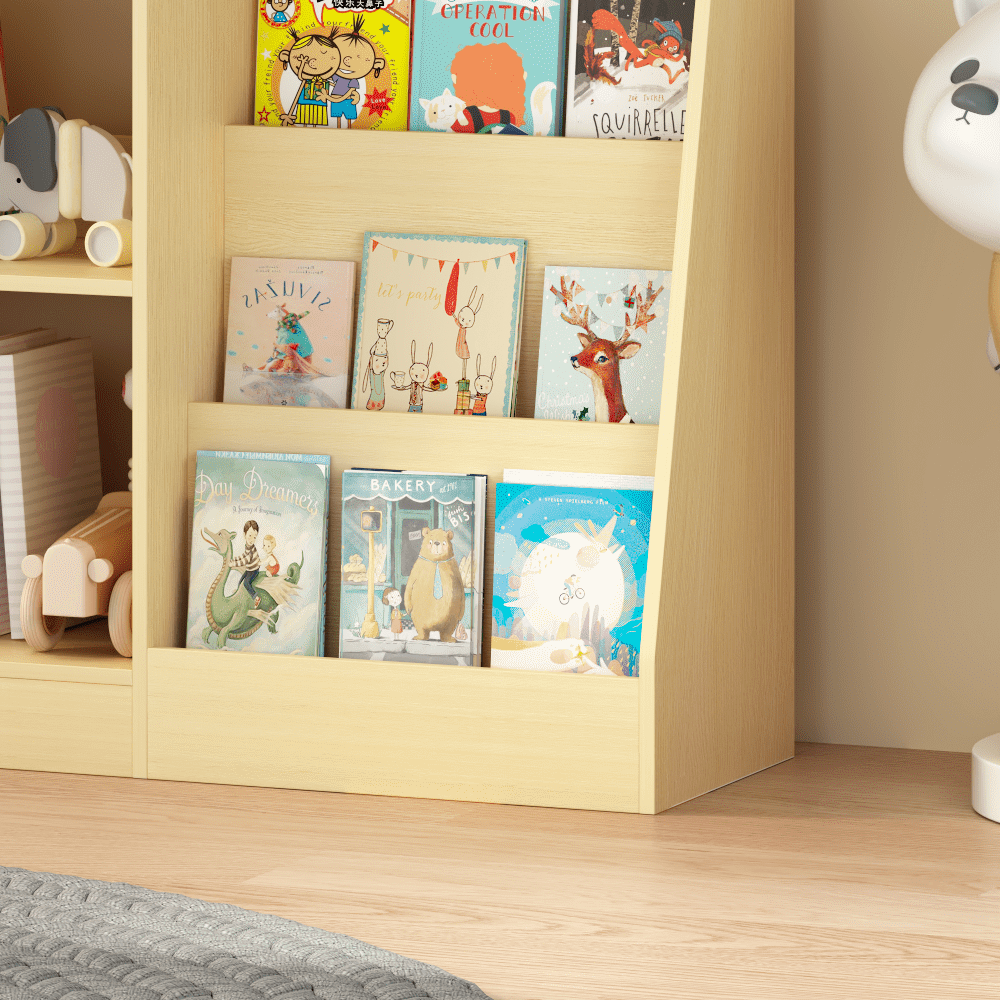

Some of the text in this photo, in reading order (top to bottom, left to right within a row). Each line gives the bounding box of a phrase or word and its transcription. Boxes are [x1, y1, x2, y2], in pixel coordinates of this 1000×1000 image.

[441, 3, 545, 22] OPERATION
[470, 22, 514, 38] COOL
[405, 286, 442, 310] party
[195, 466, 318, 517] Day Dreamers
[370, 479, 436, 493] BAKERY
